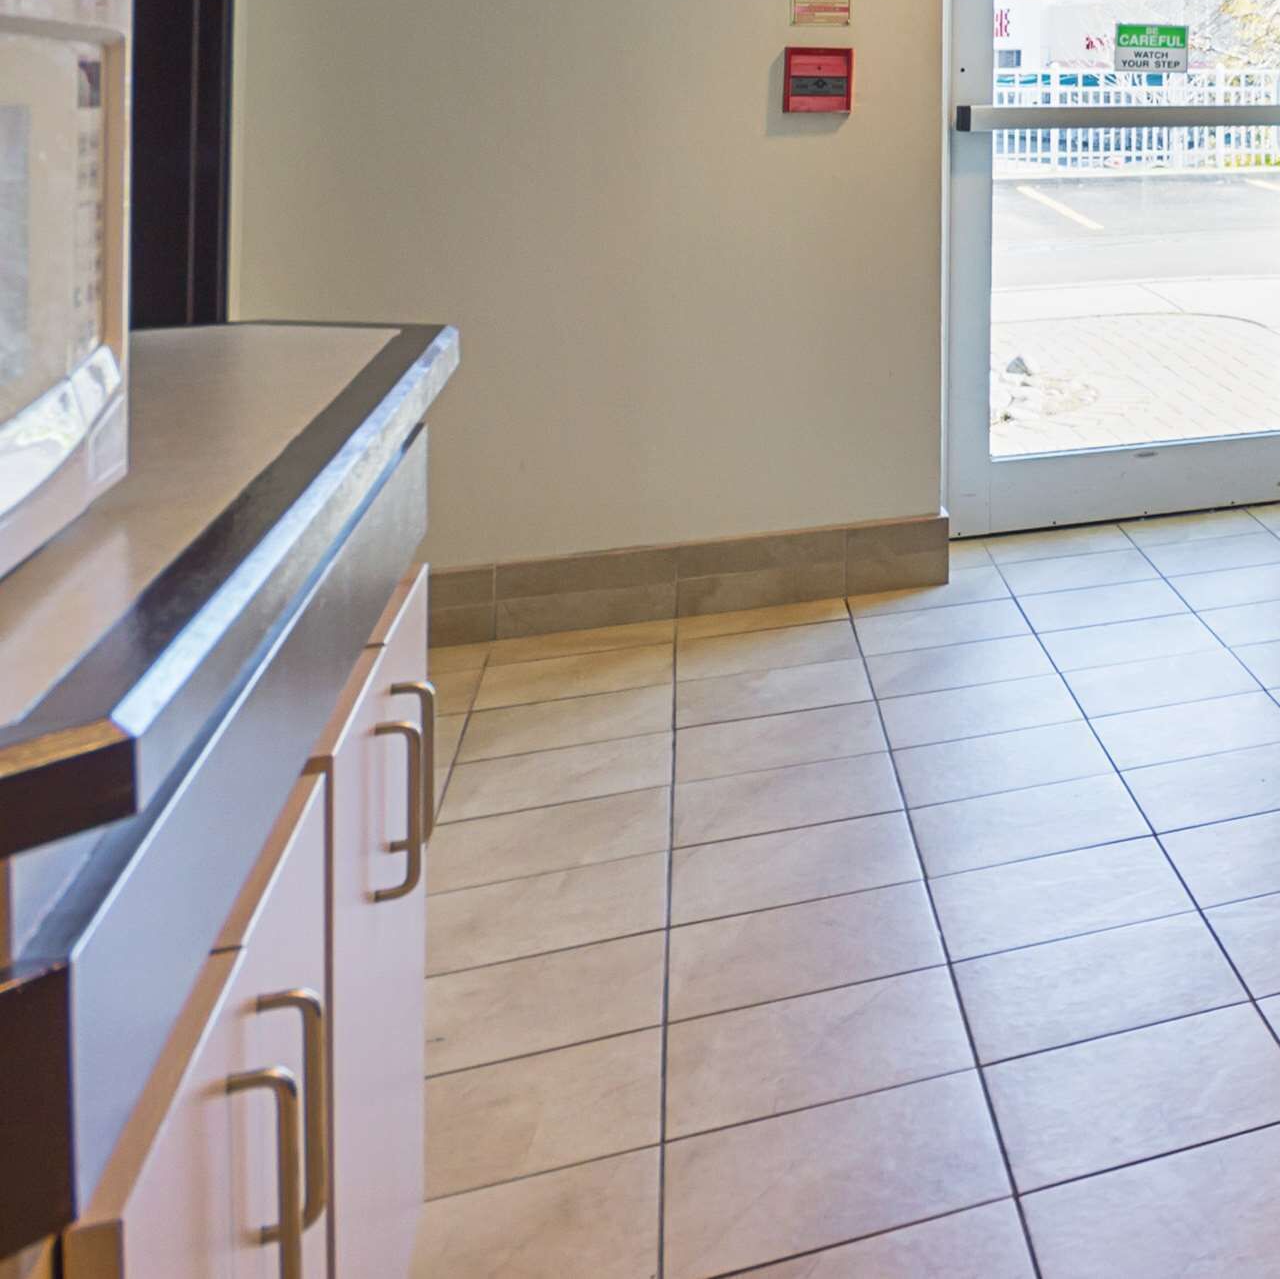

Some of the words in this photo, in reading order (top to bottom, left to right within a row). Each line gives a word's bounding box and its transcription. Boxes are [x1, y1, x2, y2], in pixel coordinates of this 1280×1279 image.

[1145, 25, 1158, 34] BE
[1119, 34, 1184, 47] CAREFUL
[1134, 51, 1169, 59] WATCH
[1121, 59, 1150, 68] YOUR
[1154, 60, 1181, 69] STEP
